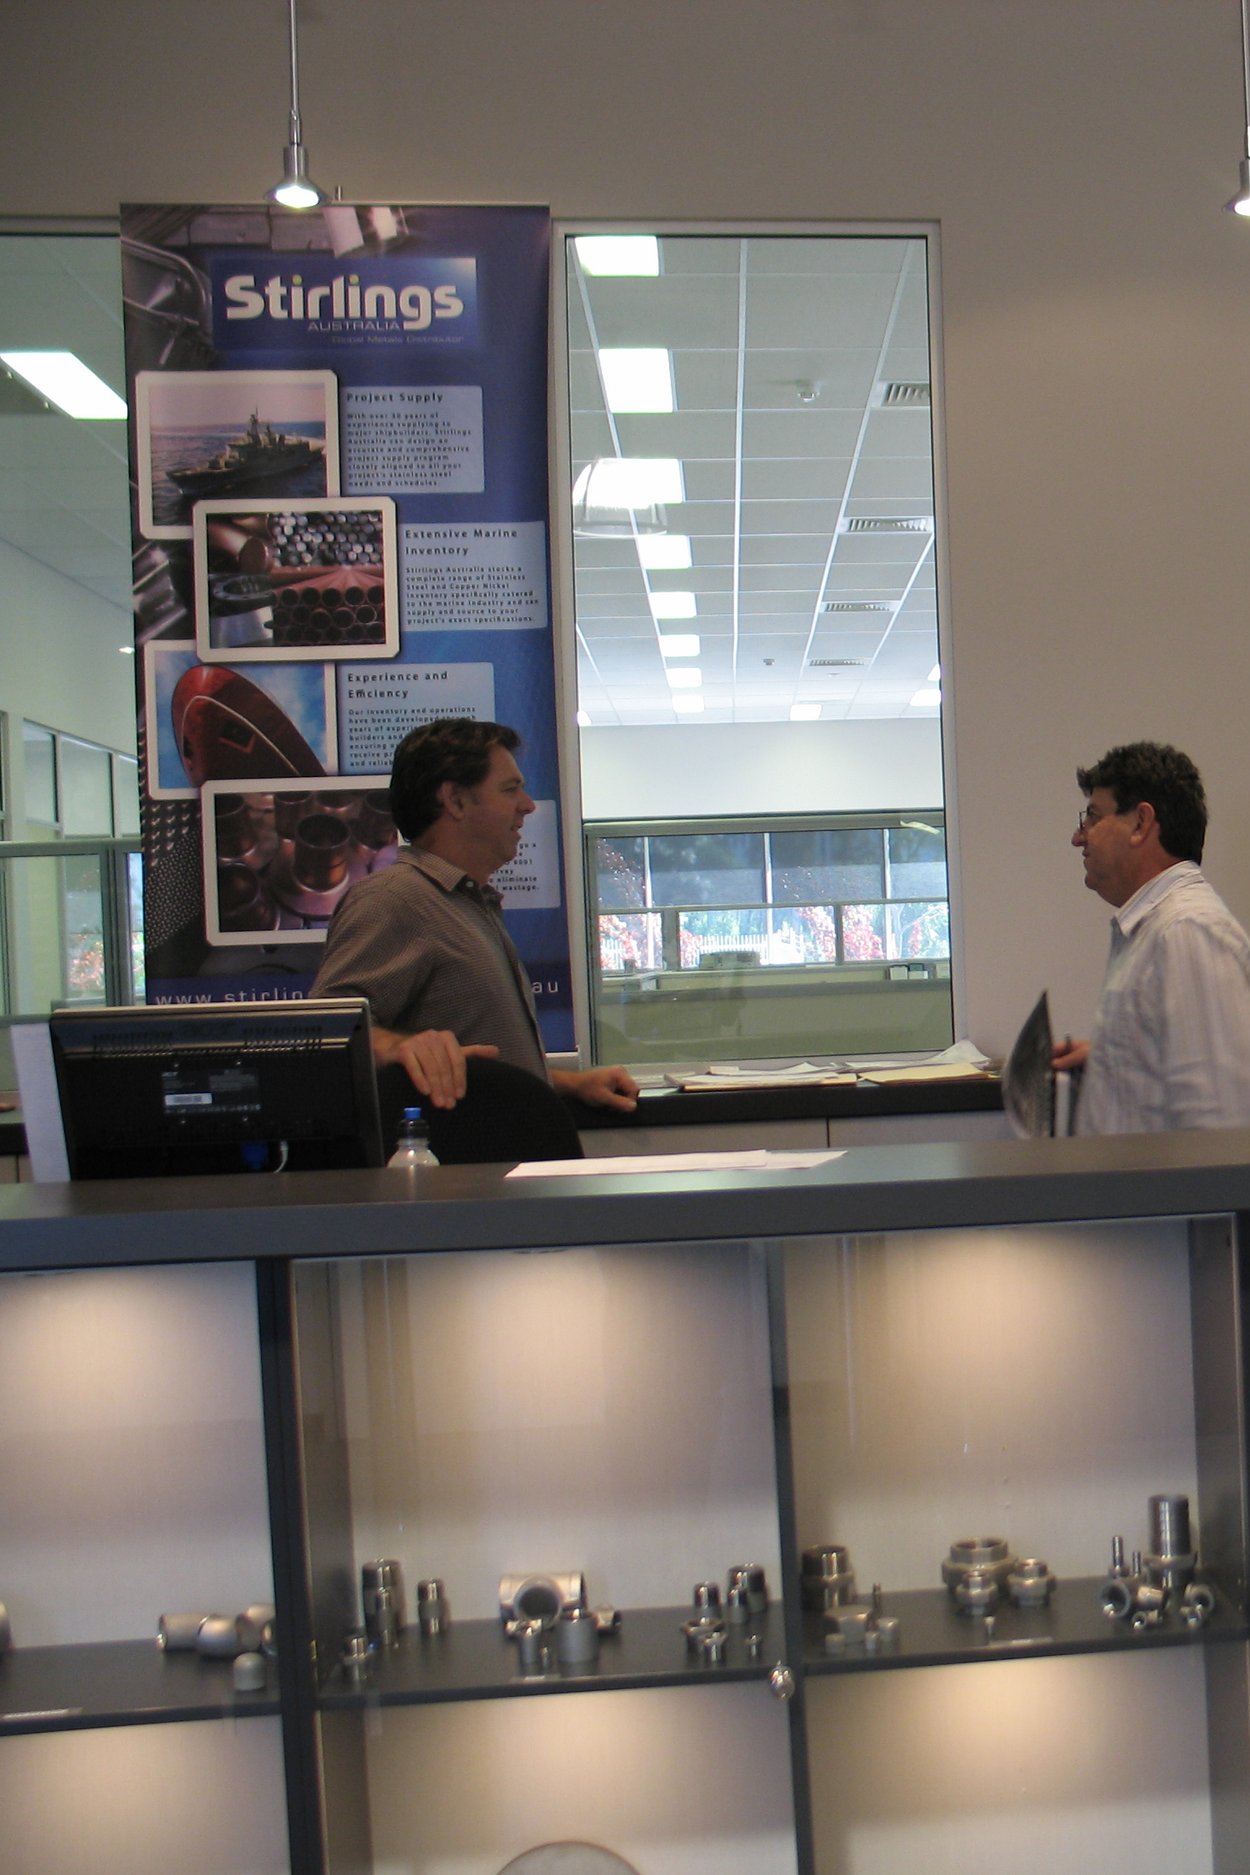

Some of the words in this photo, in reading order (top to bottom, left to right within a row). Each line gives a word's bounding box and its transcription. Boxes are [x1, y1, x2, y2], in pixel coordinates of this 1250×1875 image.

[224, 274, 463, 330] Stirlings
[308, 322, 400, 331] AUSTRALIA
[347, 392, 393, 403] Project
[400, 392, 443, 402] Supply
[405, 530, 468, 539] Extensive
[474, 529, 517, 538] Marine
[406, 546, 468, 556] Inventory
[348, 673, 418, 683] Experience
[425, 671, 448, 680] and
[348, 690, 408, 698] Efficiency
[532, 981, 558, 993] au
